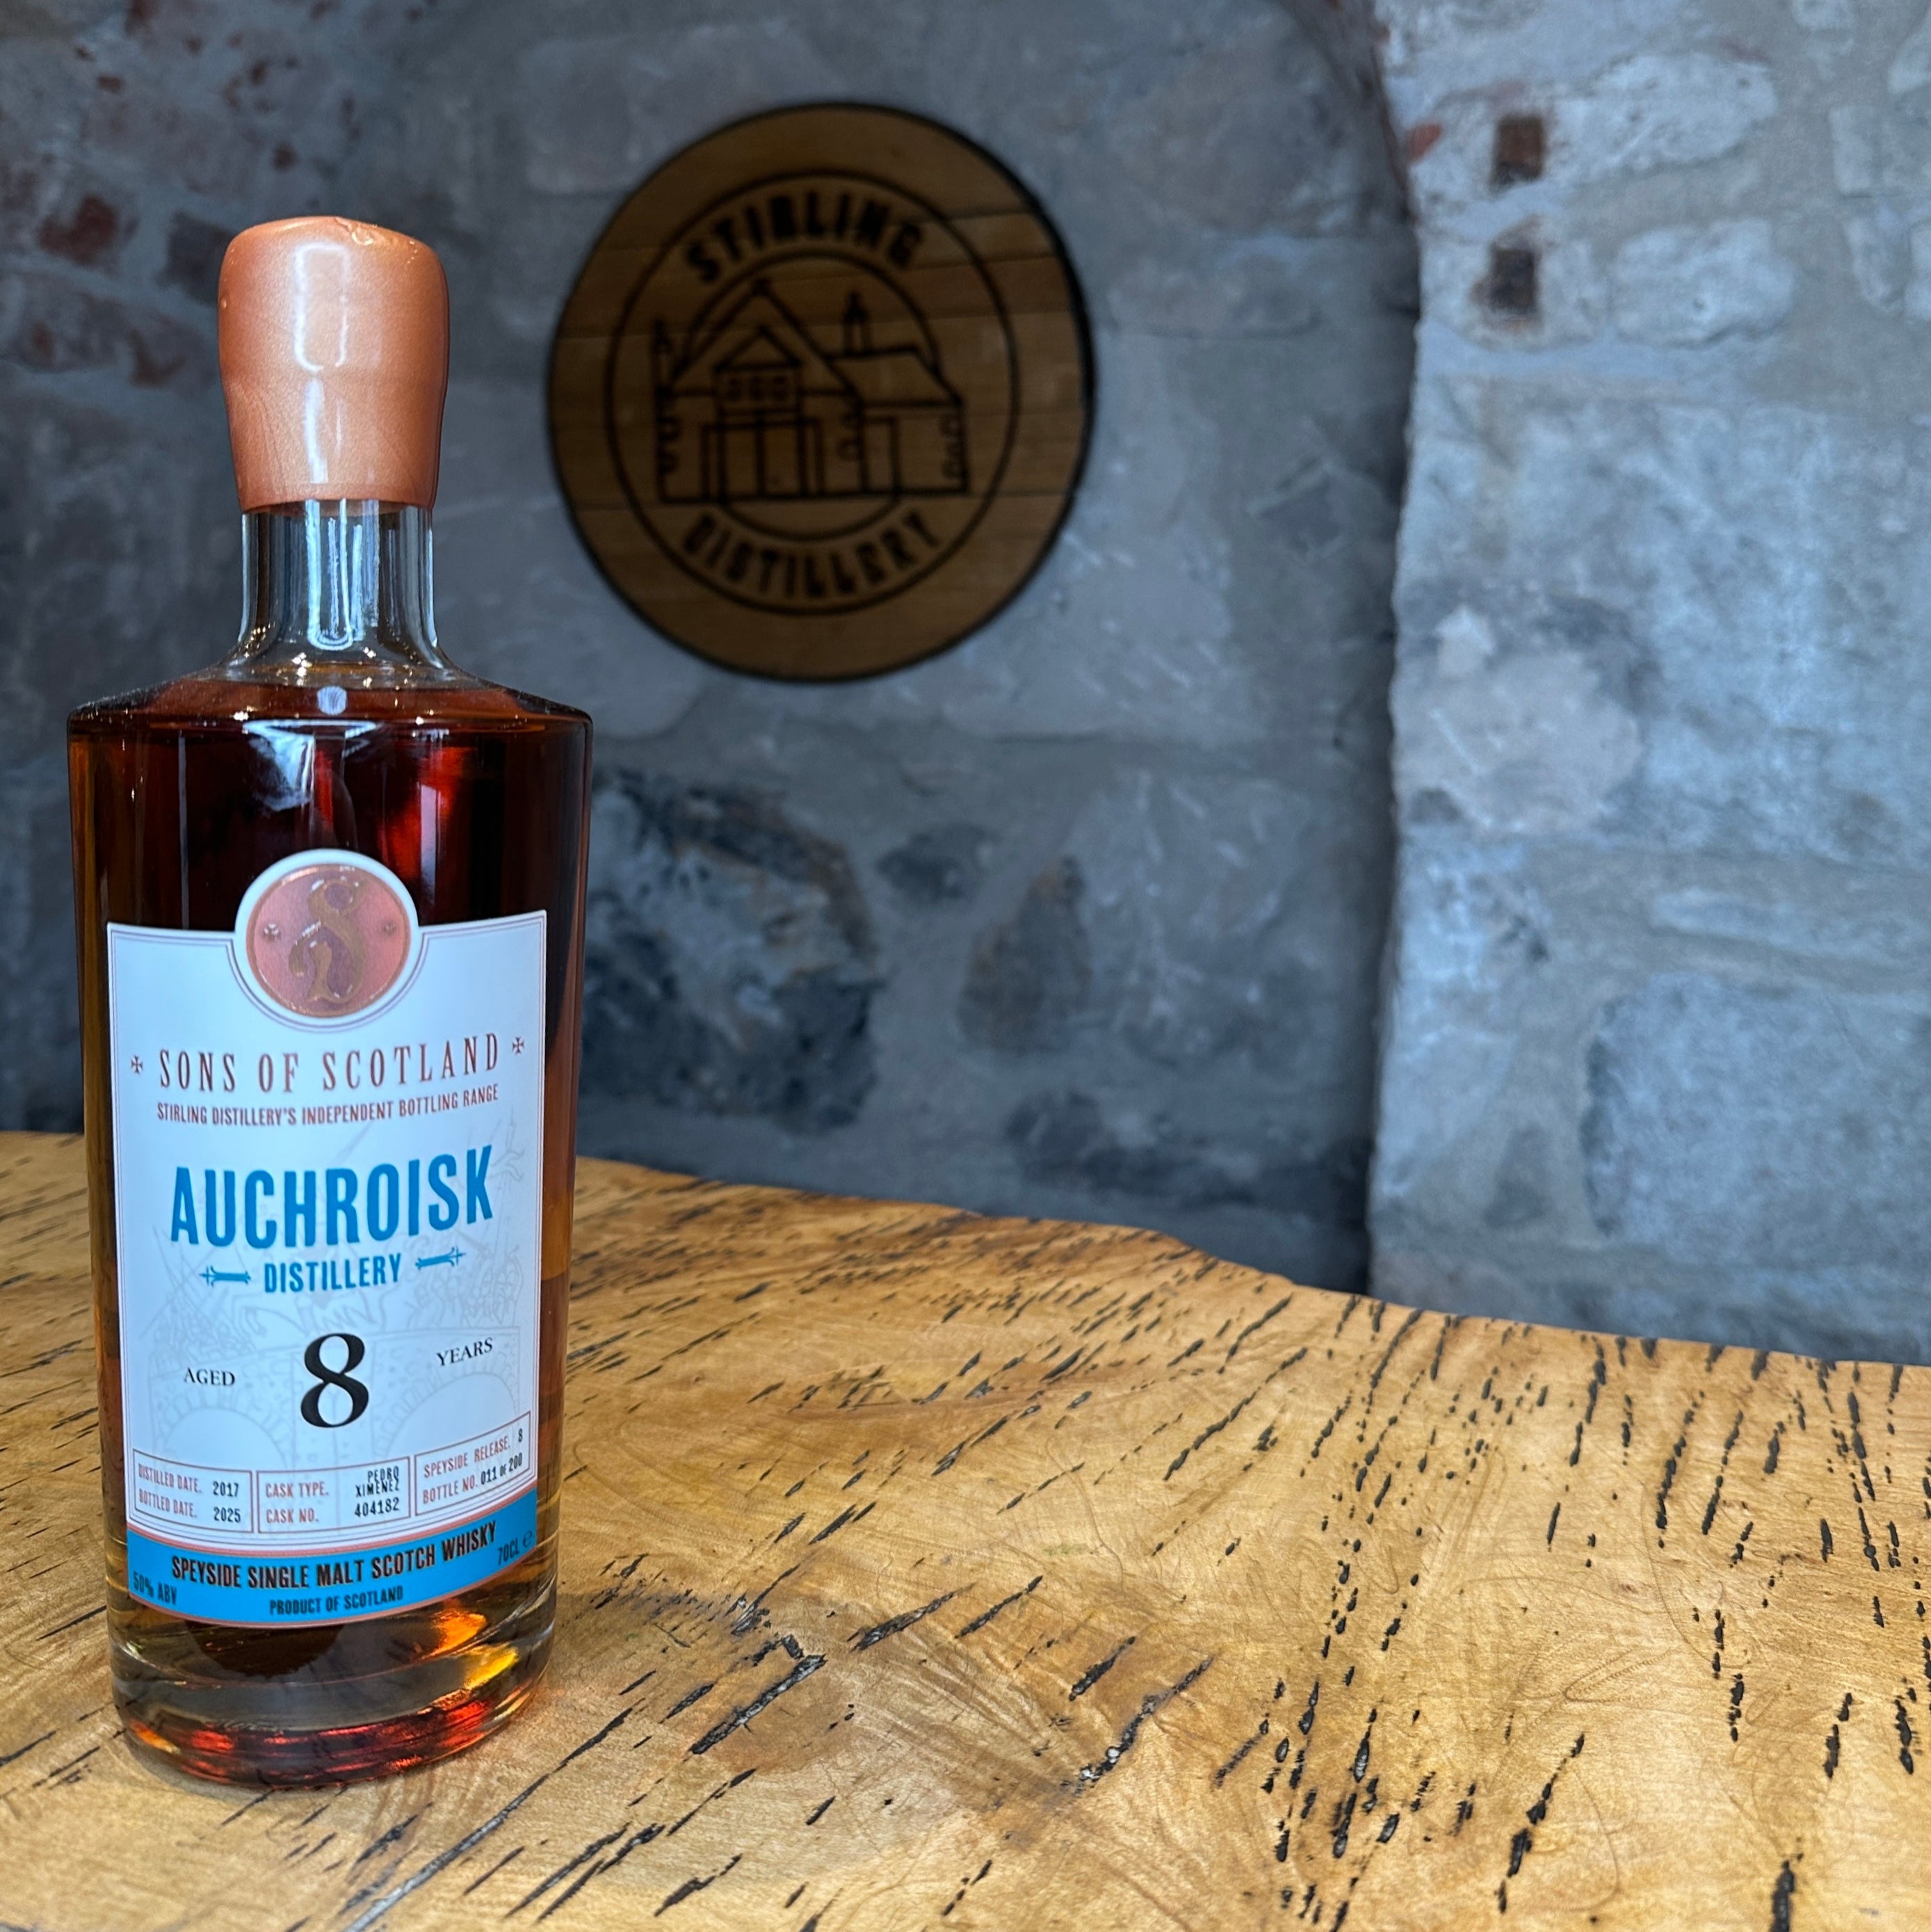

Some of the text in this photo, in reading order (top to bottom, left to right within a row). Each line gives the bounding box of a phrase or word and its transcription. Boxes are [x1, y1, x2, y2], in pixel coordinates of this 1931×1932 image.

[685, 191, 923, 282] STIRLING
[684, 512, 939, 598] DISTILLERY
[159, 1032, 499, 1093] SONS OF SCOTLAND
[157, 1083, 499, 1126] STIRLING DISTILLERY'S INDEPENDENT BOTTLING RANGE
[170, 1145, 493, 1249] AUCHROISK
[264, 1253, 401, 1294] DISTILLERY
[183, 1333, 493, 1428] AGED 8 YEARS
[423, 1428, 523, 1479] SPEYSIDE RELEASE. 8
[138, 1463, 239, 1497] DISTILLED DATE. 2017
[265, 1465, 399, 1498] CASK TYPE. PEDRO
[355, 1479, 400, 1497] XIMENEZ
[422, 1480, 459, 1504] BOTTLE
[462, 1474, 478, 1492] NO.
[480, 1466, 497, 1485] 011
[508, 1452, 523, 1472] 200
[138, 1488, 241, 1523] BOTTLED DATE. 2025
[266, 1497, 400, 1524] CASK NO. 404182
[172, 1520, 496, 1588] SPEYSIDE SINGLE MALT SCOTCH WHISKY
[497, 1542, 519, 1565] 70CL
[133, 1571, 177, 1605] 50% ABV
[270, 1586, 403, 1616] PRODUCT OF SCOTLAND
